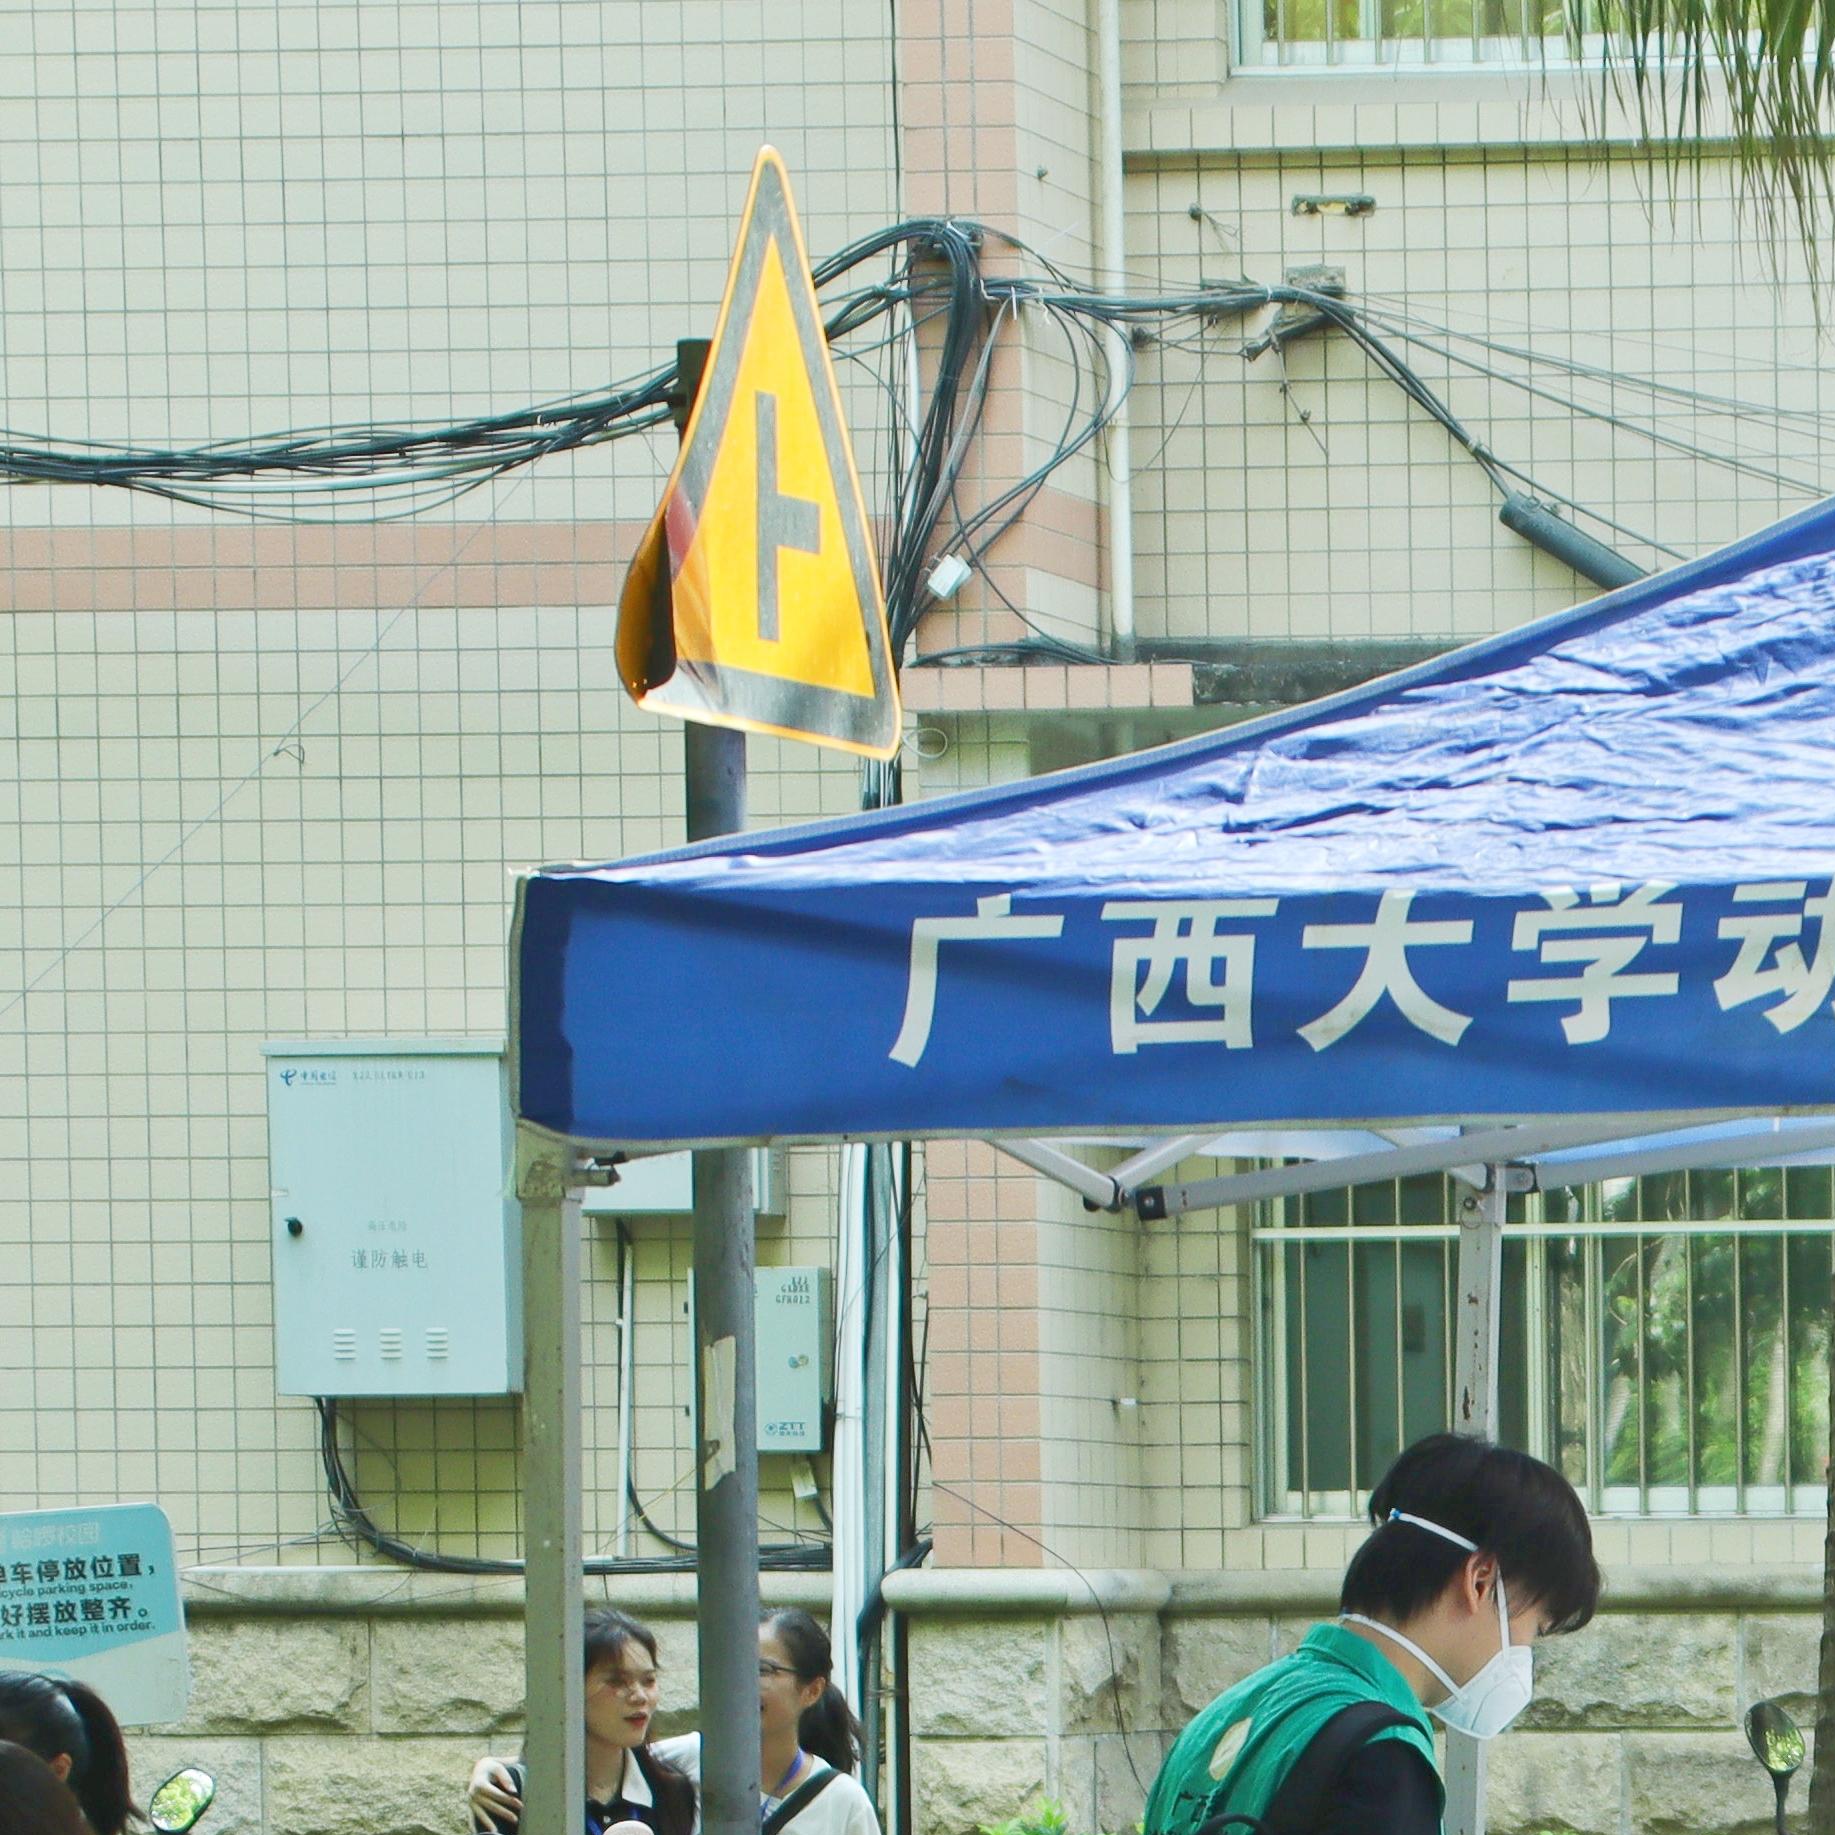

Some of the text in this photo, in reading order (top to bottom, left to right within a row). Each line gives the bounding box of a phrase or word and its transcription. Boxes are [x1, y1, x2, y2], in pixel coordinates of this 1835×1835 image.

[351, 1248, 429, 1270] 谨防触电
[37, 1584, 86, 1597] parking
[29, 1627, 52, 1639] and
[55, 1624, 87, 1638] keep
[90, 1623, 100, 1634] it
[102, 1622, 114, 1632] in
